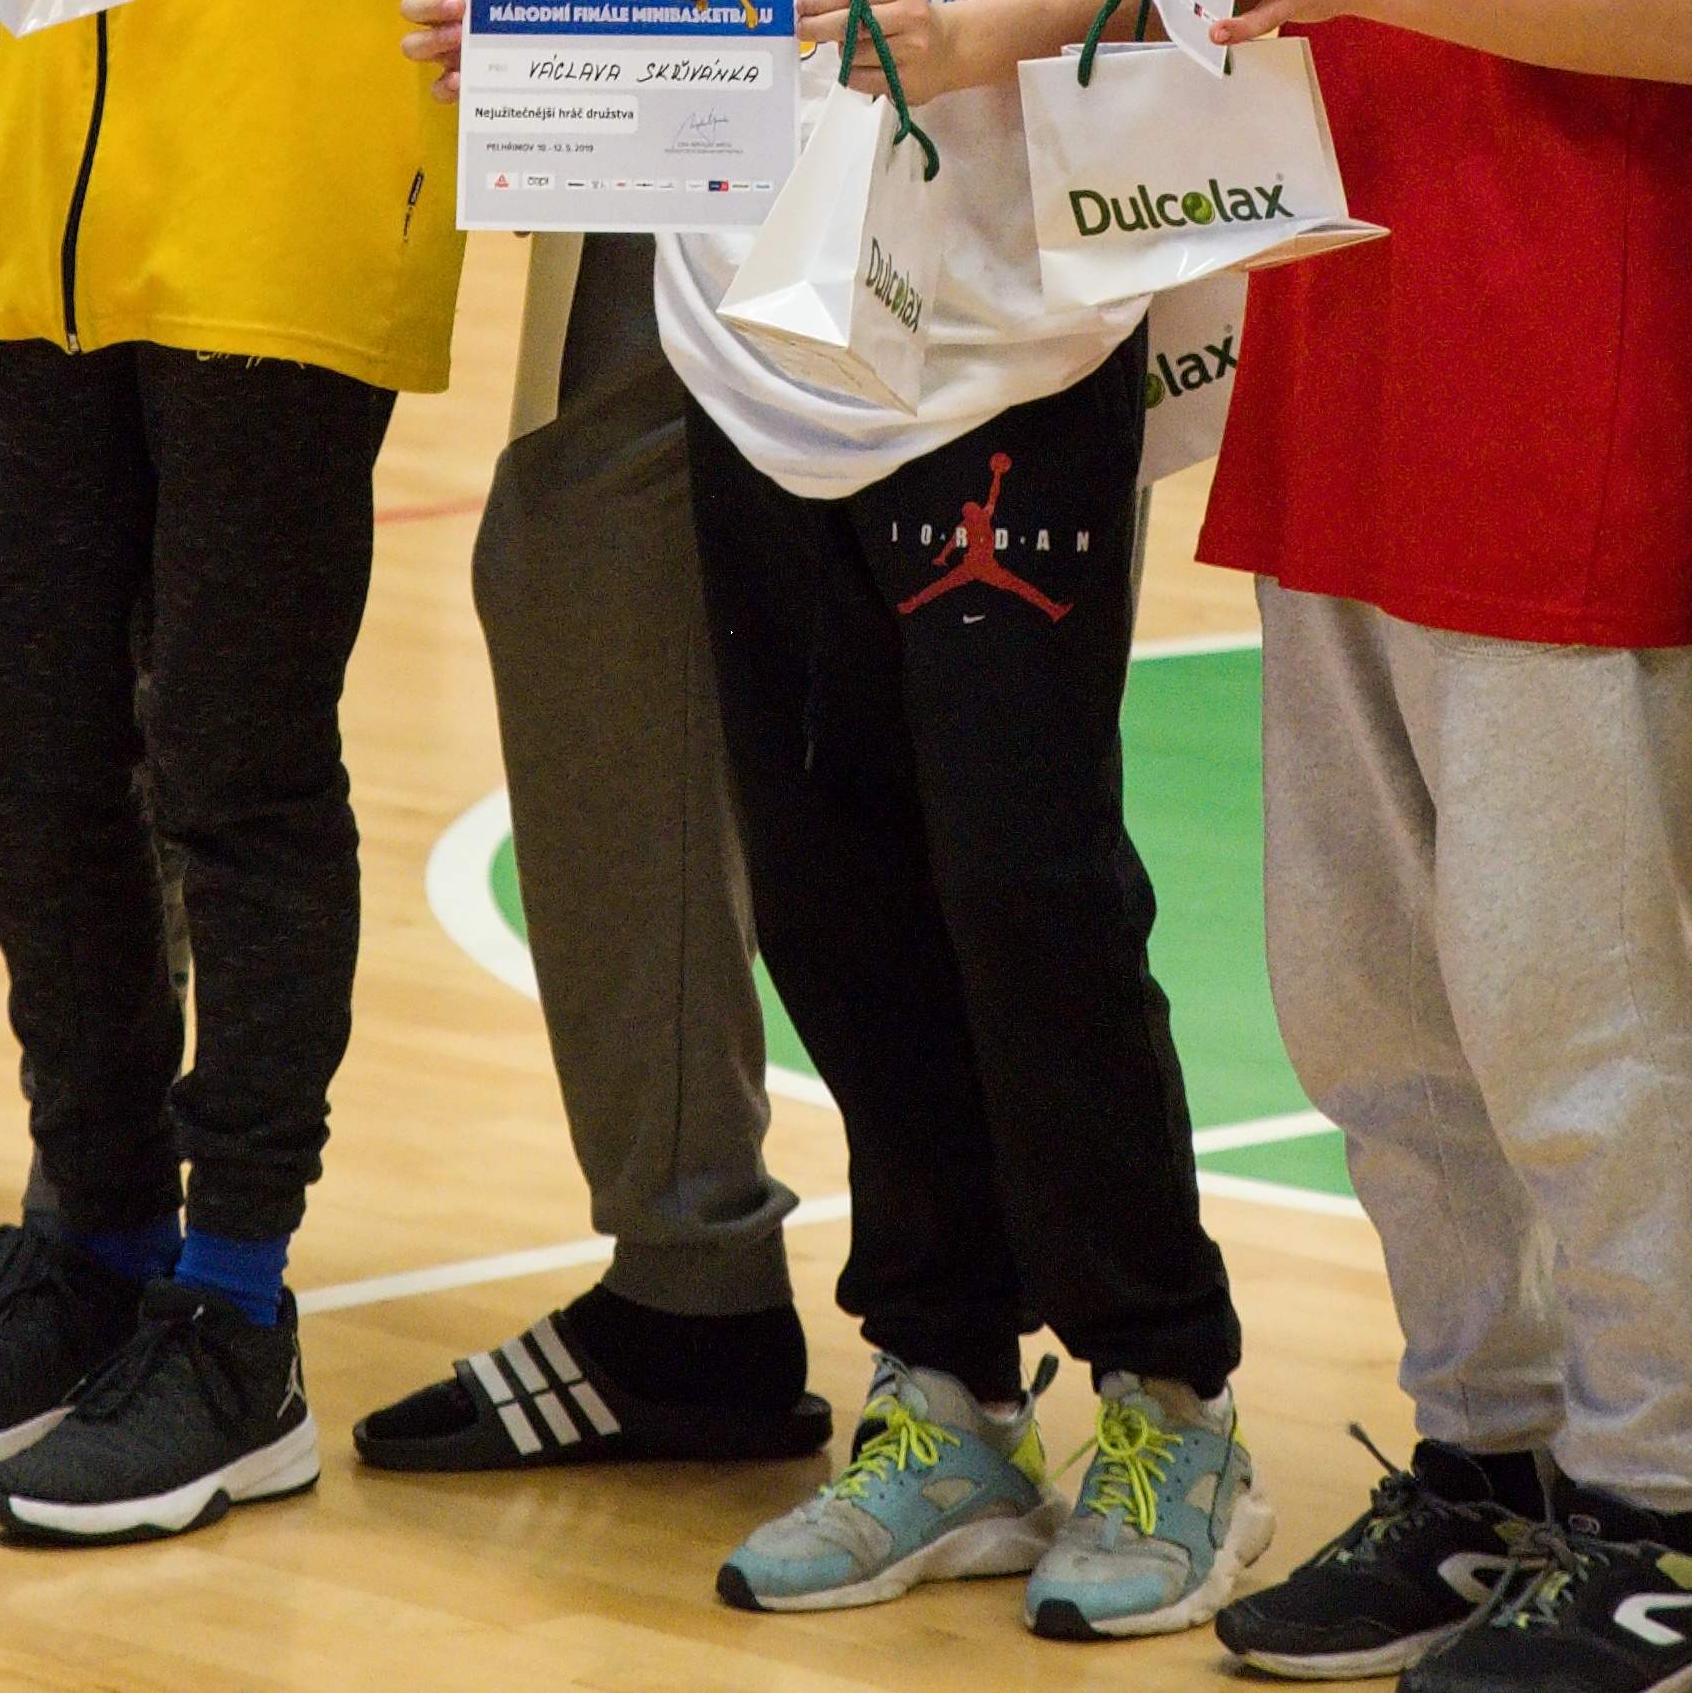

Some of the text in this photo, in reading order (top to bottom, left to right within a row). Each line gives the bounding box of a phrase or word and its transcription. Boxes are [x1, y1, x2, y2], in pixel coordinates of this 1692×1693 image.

[489, 2, 774, 24] NÁRODNÍ FINÁLE MINIBASKETBAU
[529, 54, 761, 84] VÁCLAVA SKŘIVÁNKA
[475, 107, 635, 121] Nejužitečnější hráč družstva
[1068, 179, 1295, 238] Dulcolax
[865, 236, 923, 334] Dulcolax
